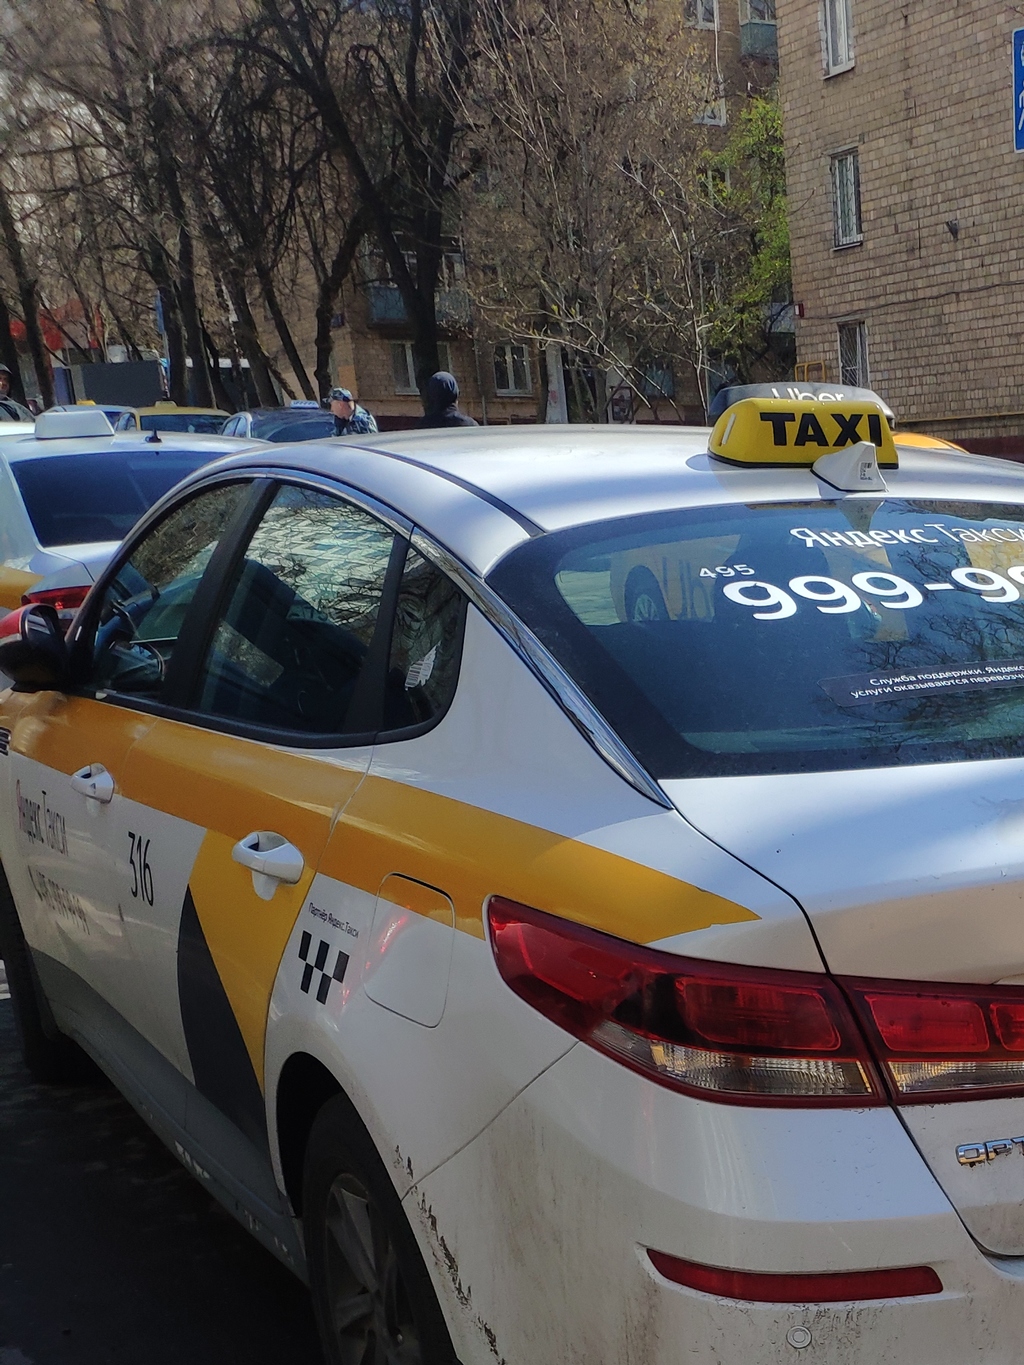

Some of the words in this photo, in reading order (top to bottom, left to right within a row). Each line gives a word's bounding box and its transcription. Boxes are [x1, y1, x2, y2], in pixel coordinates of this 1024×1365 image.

[759, 412, 883, 448] TAXI
[699, 564, 755, 579] 495
[850, 686, 893, 699] услуги
[893, 677, 969, 691] оказываются
[869, 673, 917, 686] Служба
[917, 668, 985, 680] поддержки.
[128, 831, 154, 906] 316
